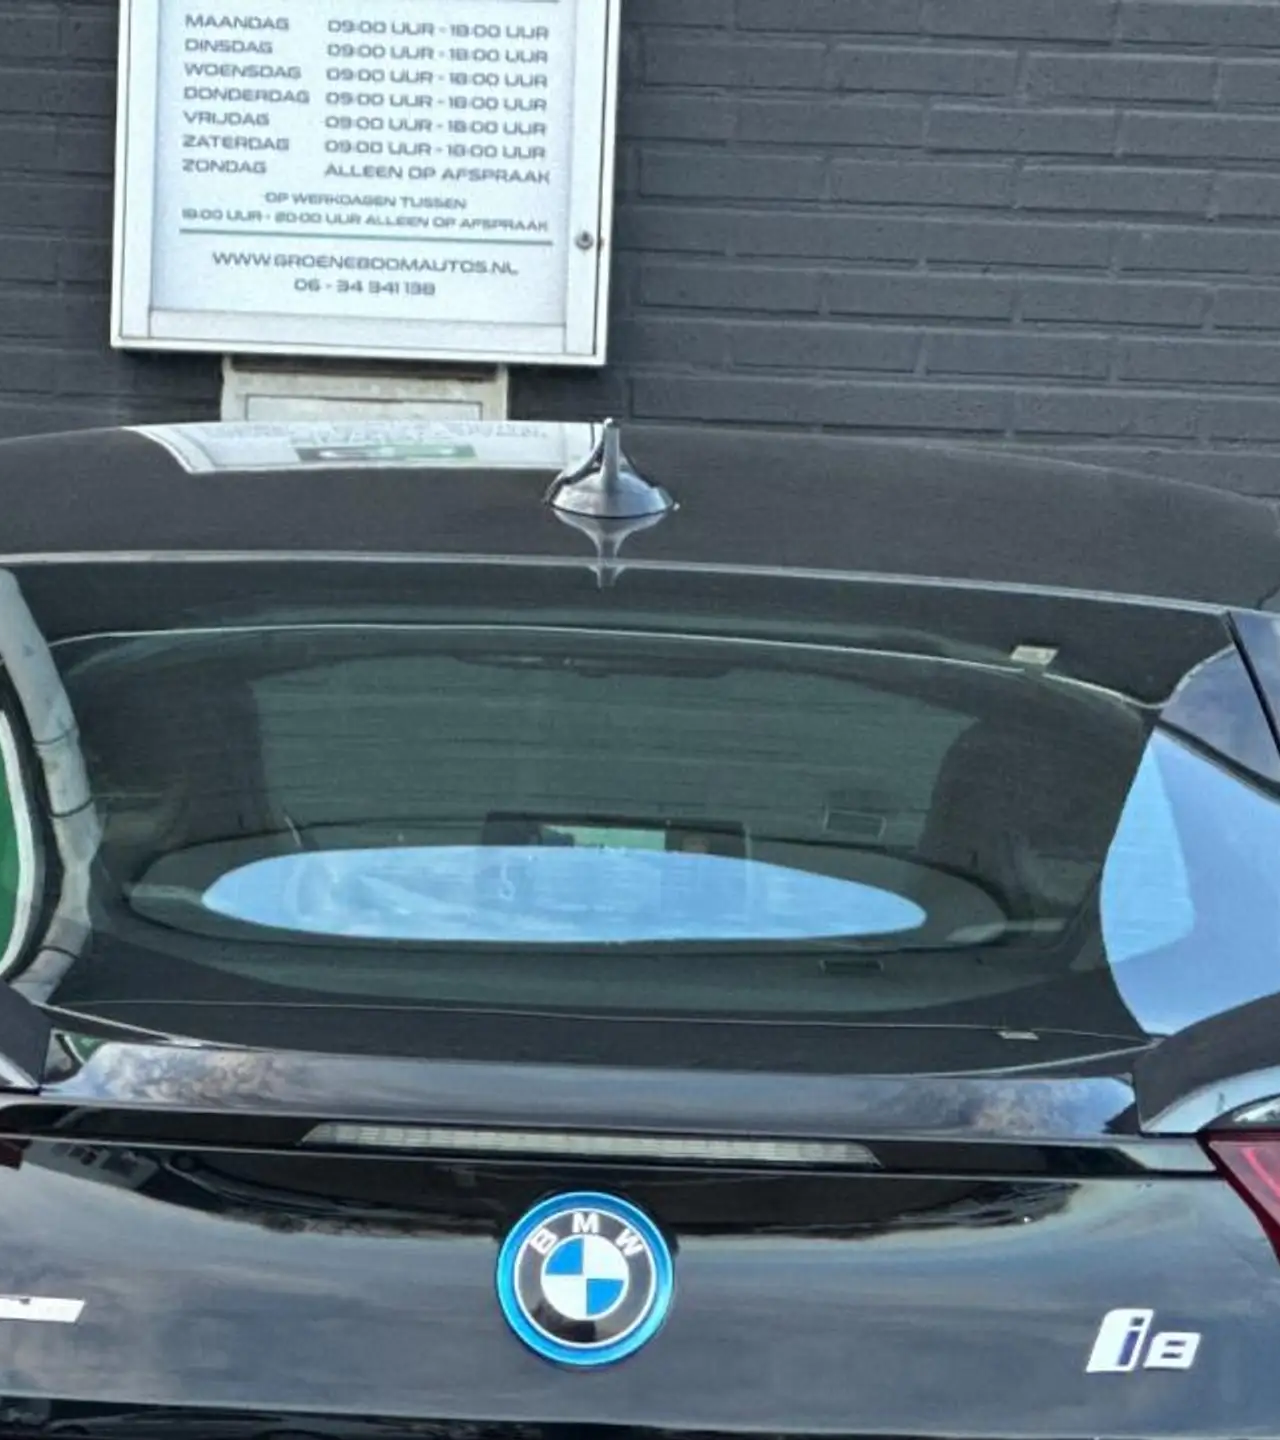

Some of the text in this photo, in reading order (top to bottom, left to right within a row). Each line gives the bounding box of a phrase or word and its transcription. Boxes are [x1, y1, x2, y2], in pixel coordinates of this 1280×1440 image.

[185, 14, 289, 32] MAANDAG
[328, 19, 387, 34] 09:00
[391, 21, 435, 37] UUR
[449, 24, 501, 39] 18:00
[505, 25, 549, 40] UUR
[185, 38, 273, 54] DINSDAG
[327, 43, 386, 59] 09:00
[390, 46, 434, 60] UUR
[449, 48, 500, 62] 18:00
[505, 49, 548, 64] UUR
[184, 62, 302, 80] WOENSDAG
[326, 67, 385, 83] 09:00
[390, 69, 434, 84] UUR
[449, 72, 500, 87] 18:00
[504, 73, 548, 88] UUR
[184, 86, 310, 104] DONDERDAG
[325, 92, 385, 107] 09:00
[389, 94, 433, 108] UUR
[448, 96, 499, 111] 18:00
[503, 98, 547, 112] UUR
[183, 110, 270, 126] VRIJDAG
[324, 115, 384, 131] 09:00
[388, 118, 433, 132] UUR
[448, 120, 499, 135] 18:00
[503, 122, 547, 136] UUR
[182, 134, 289, 151] ZATERDAG
[324, 139, 383, 154] 09:00
[387, 142, 432, 156] UUR
[446, 143, 498, 158] 18:00
[502, 145, 546, 160] UUR
[182, 158, 550, 185] ZONDAG ALLEEN OP AFSPRAAK
[264, 192, 467, 210] OP WERKDAGEN TUSSEN
[226, 210, 263, 222] UUR
[325, 213, 362, 225] UUR
[364, 214, 429, 228] ALLEEN
[432, 216, 457, 228] OP
[459, 218, 548, 232] AFSPRAAK
[294, 278, 321, 292] 06
[528, 1211, 645, 1257] BMW
[1085, 1308, 1202, 1374] i8
